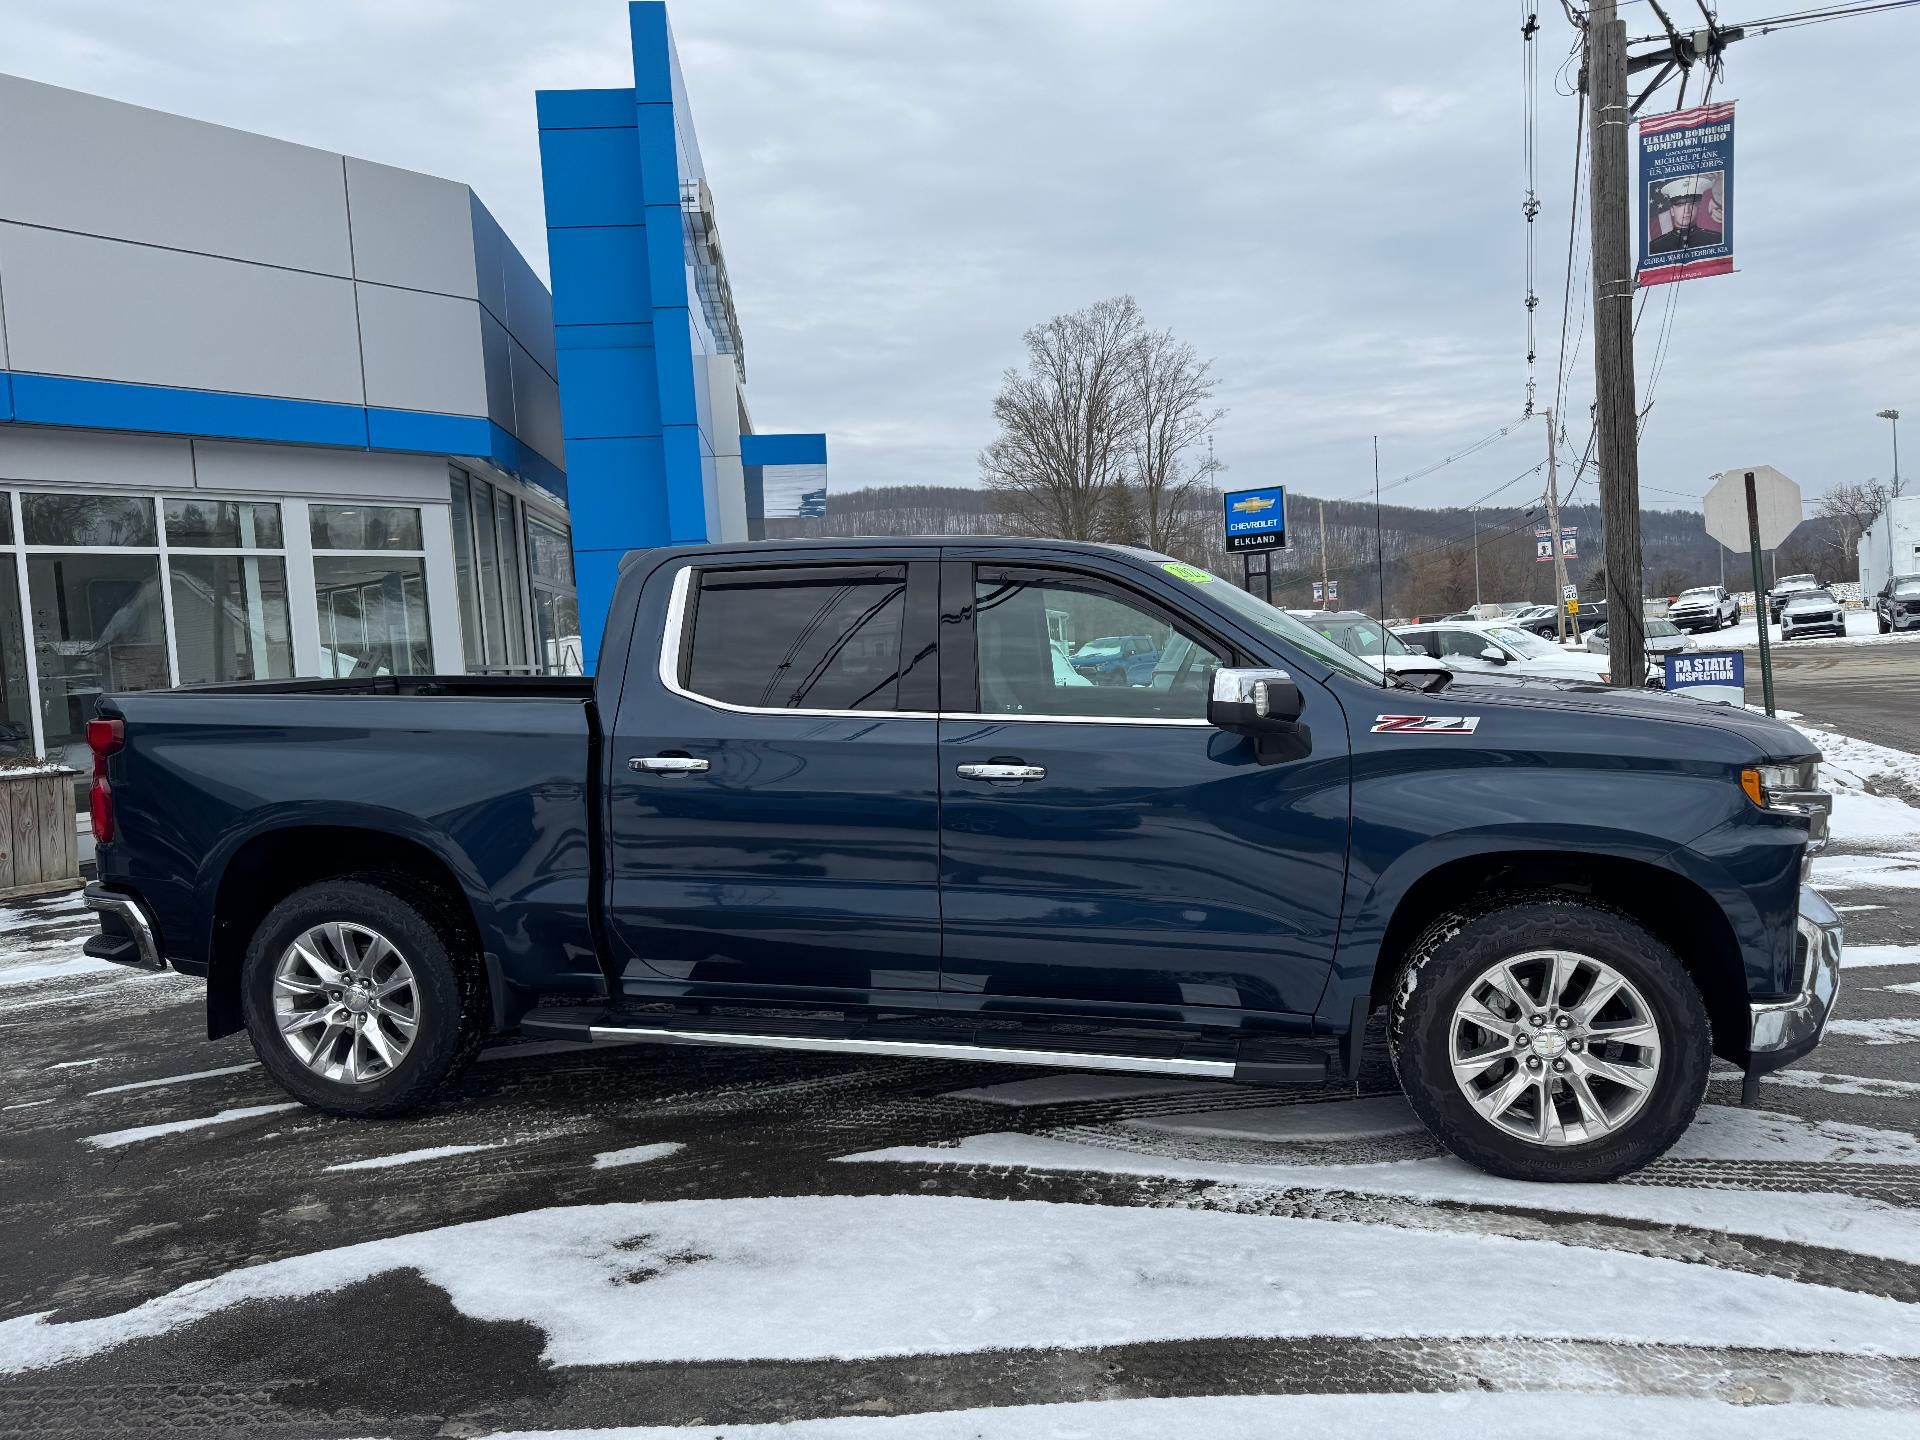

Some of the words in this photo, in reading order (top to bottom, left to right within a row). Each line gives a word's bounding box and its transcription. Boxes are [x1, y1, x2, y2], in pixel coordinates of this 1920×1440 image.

[1643, 132, 1682, 146] ELKLAND
[1685, 124, 1731, 138] BOROUGH
[1647, 138, 1698, 152] HOMETOWN
[1701, 133, 1726, 144] HERO
[1654, 156, 1690, 167] MICHAEL
[1692, 150, 1718, 161] PLANK
[1664, 163, 1696, 173] MARINE
[1697, 159, 1723, 169] CORPS
[1230, 518, 1279, 531] CHEVROLET
[1234, 535, 1275, 546] ELKLAND
[1675, 660, 1692, 672] PA
[1694, 657, 1733, 671] STATE
[1675, 670, 1734, 682] INSPECTION
[1370, 714, 1481, 734] Z71
